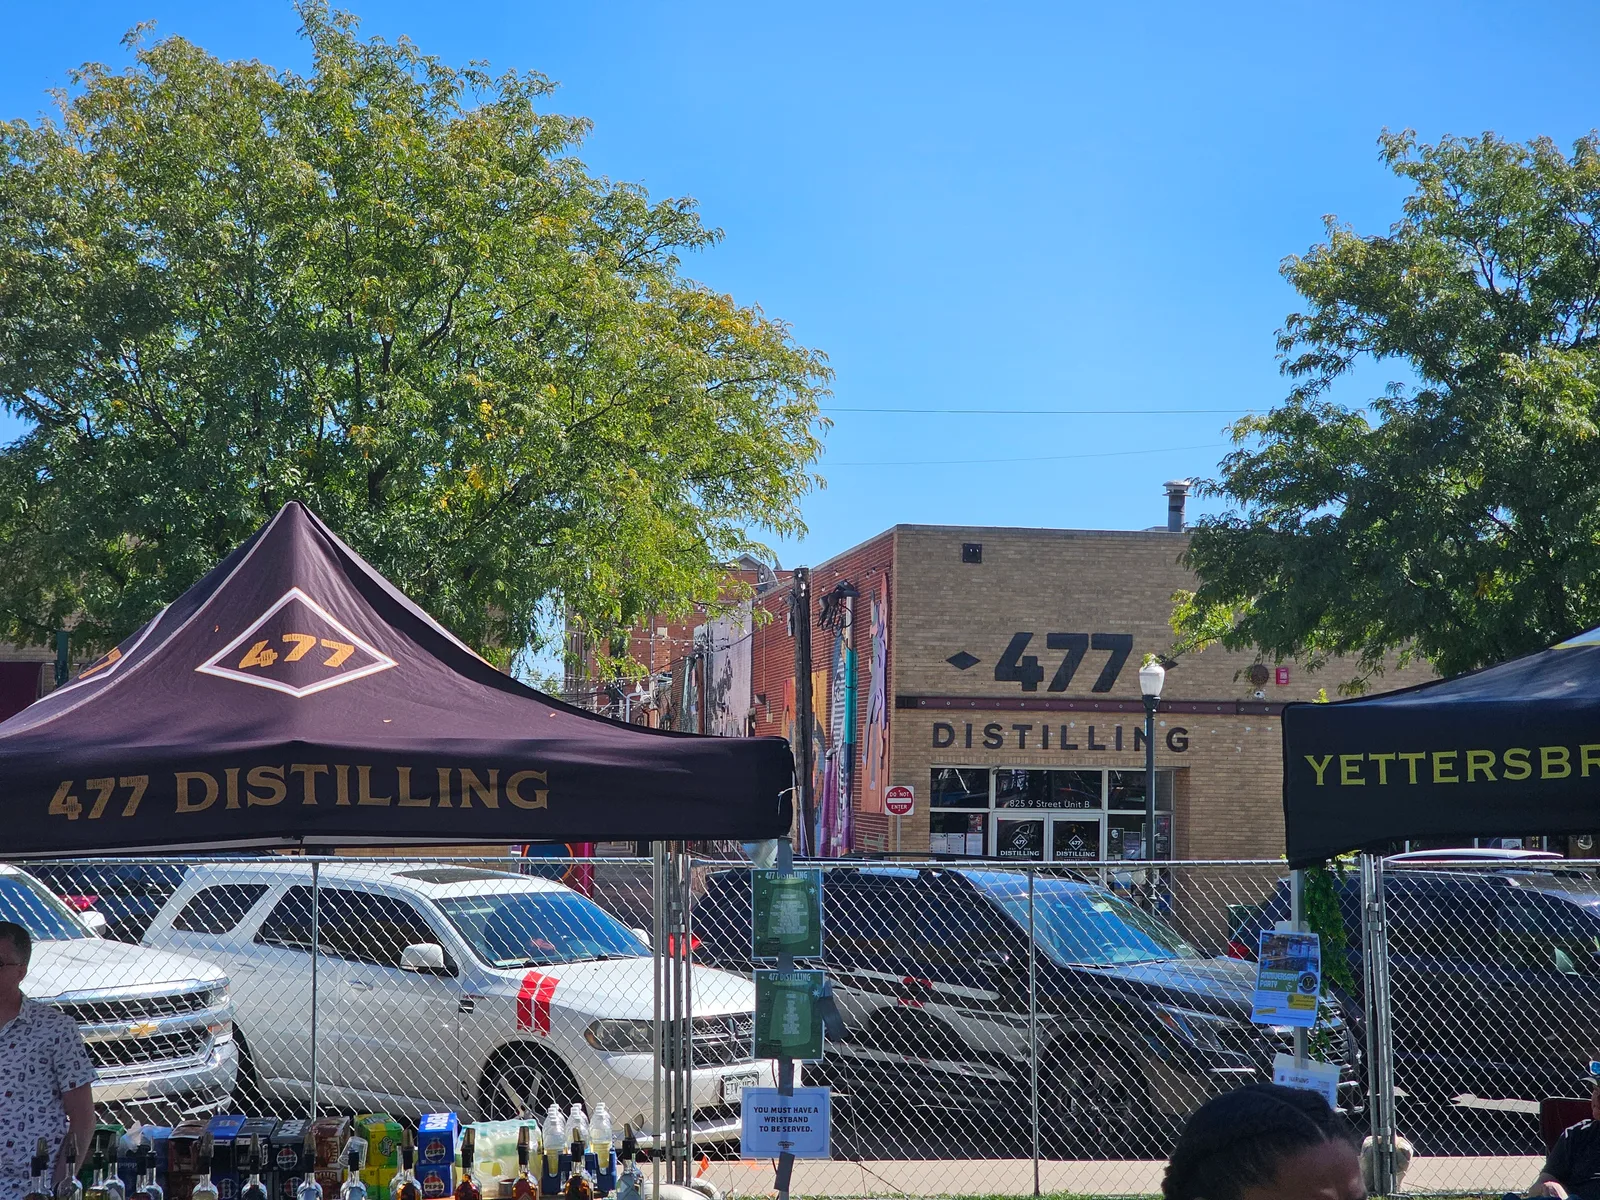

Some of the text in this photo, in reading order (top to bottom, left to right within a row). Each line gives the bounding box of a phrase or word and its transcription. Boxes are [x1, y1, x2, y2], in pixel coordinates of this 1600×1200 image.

[239, 633, 355, 669] 477
[994, 632, 1133, 692] 477
[932, 722, 1189, 753] DISTILLING
[1304, 744, 1600, 786] YETTERSBR
[48, 763, 550, 821] 477 DISTILLING
[1009, 800, 1026, 808] 825
[1036, 800, 1062, 808] Street
[1064, 800, 1082, 808] Unit
[1084, 800, 1090, 808] B
[765, 871, 776, 880] 477
[768, 973, 778, 981] 477
[1260, 980, 1278, 988] PARTY
[277, 1119, 305, 1137] PEPSI
[425, 1113, 449, 1130] PEPSI
